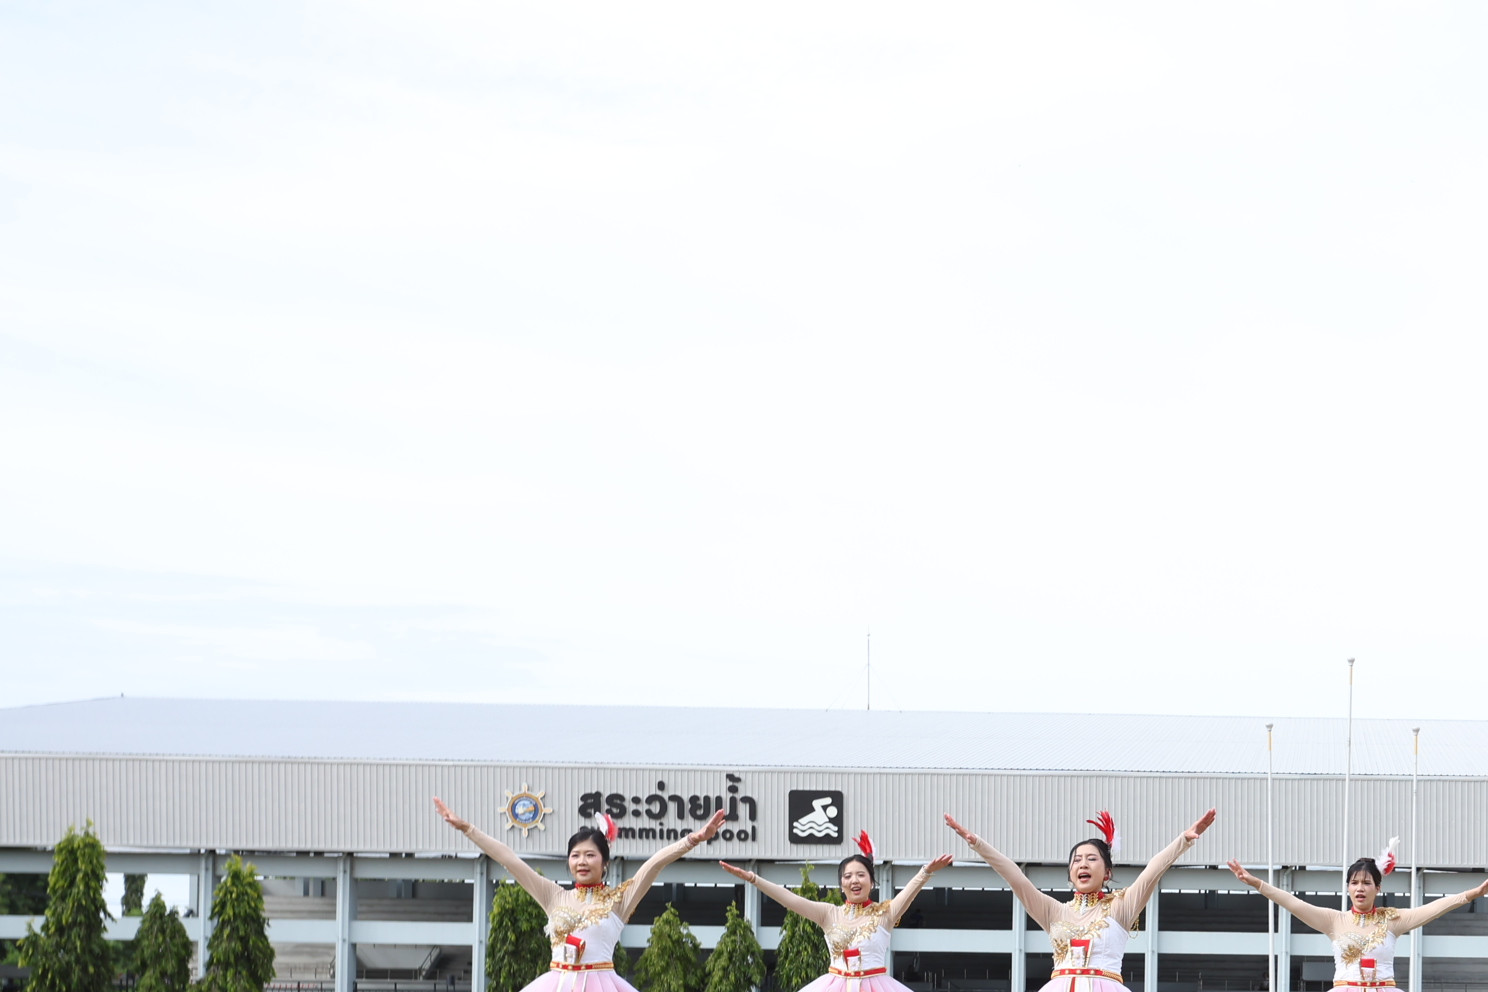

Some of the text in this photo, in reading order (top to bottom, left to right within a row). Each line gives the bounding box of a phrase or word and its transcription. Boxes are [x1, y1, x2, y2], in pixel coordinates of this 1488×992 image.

[578, 773, 757, 822] สระว่ายน้ำ
[579, 821, 693, 842] mmin
